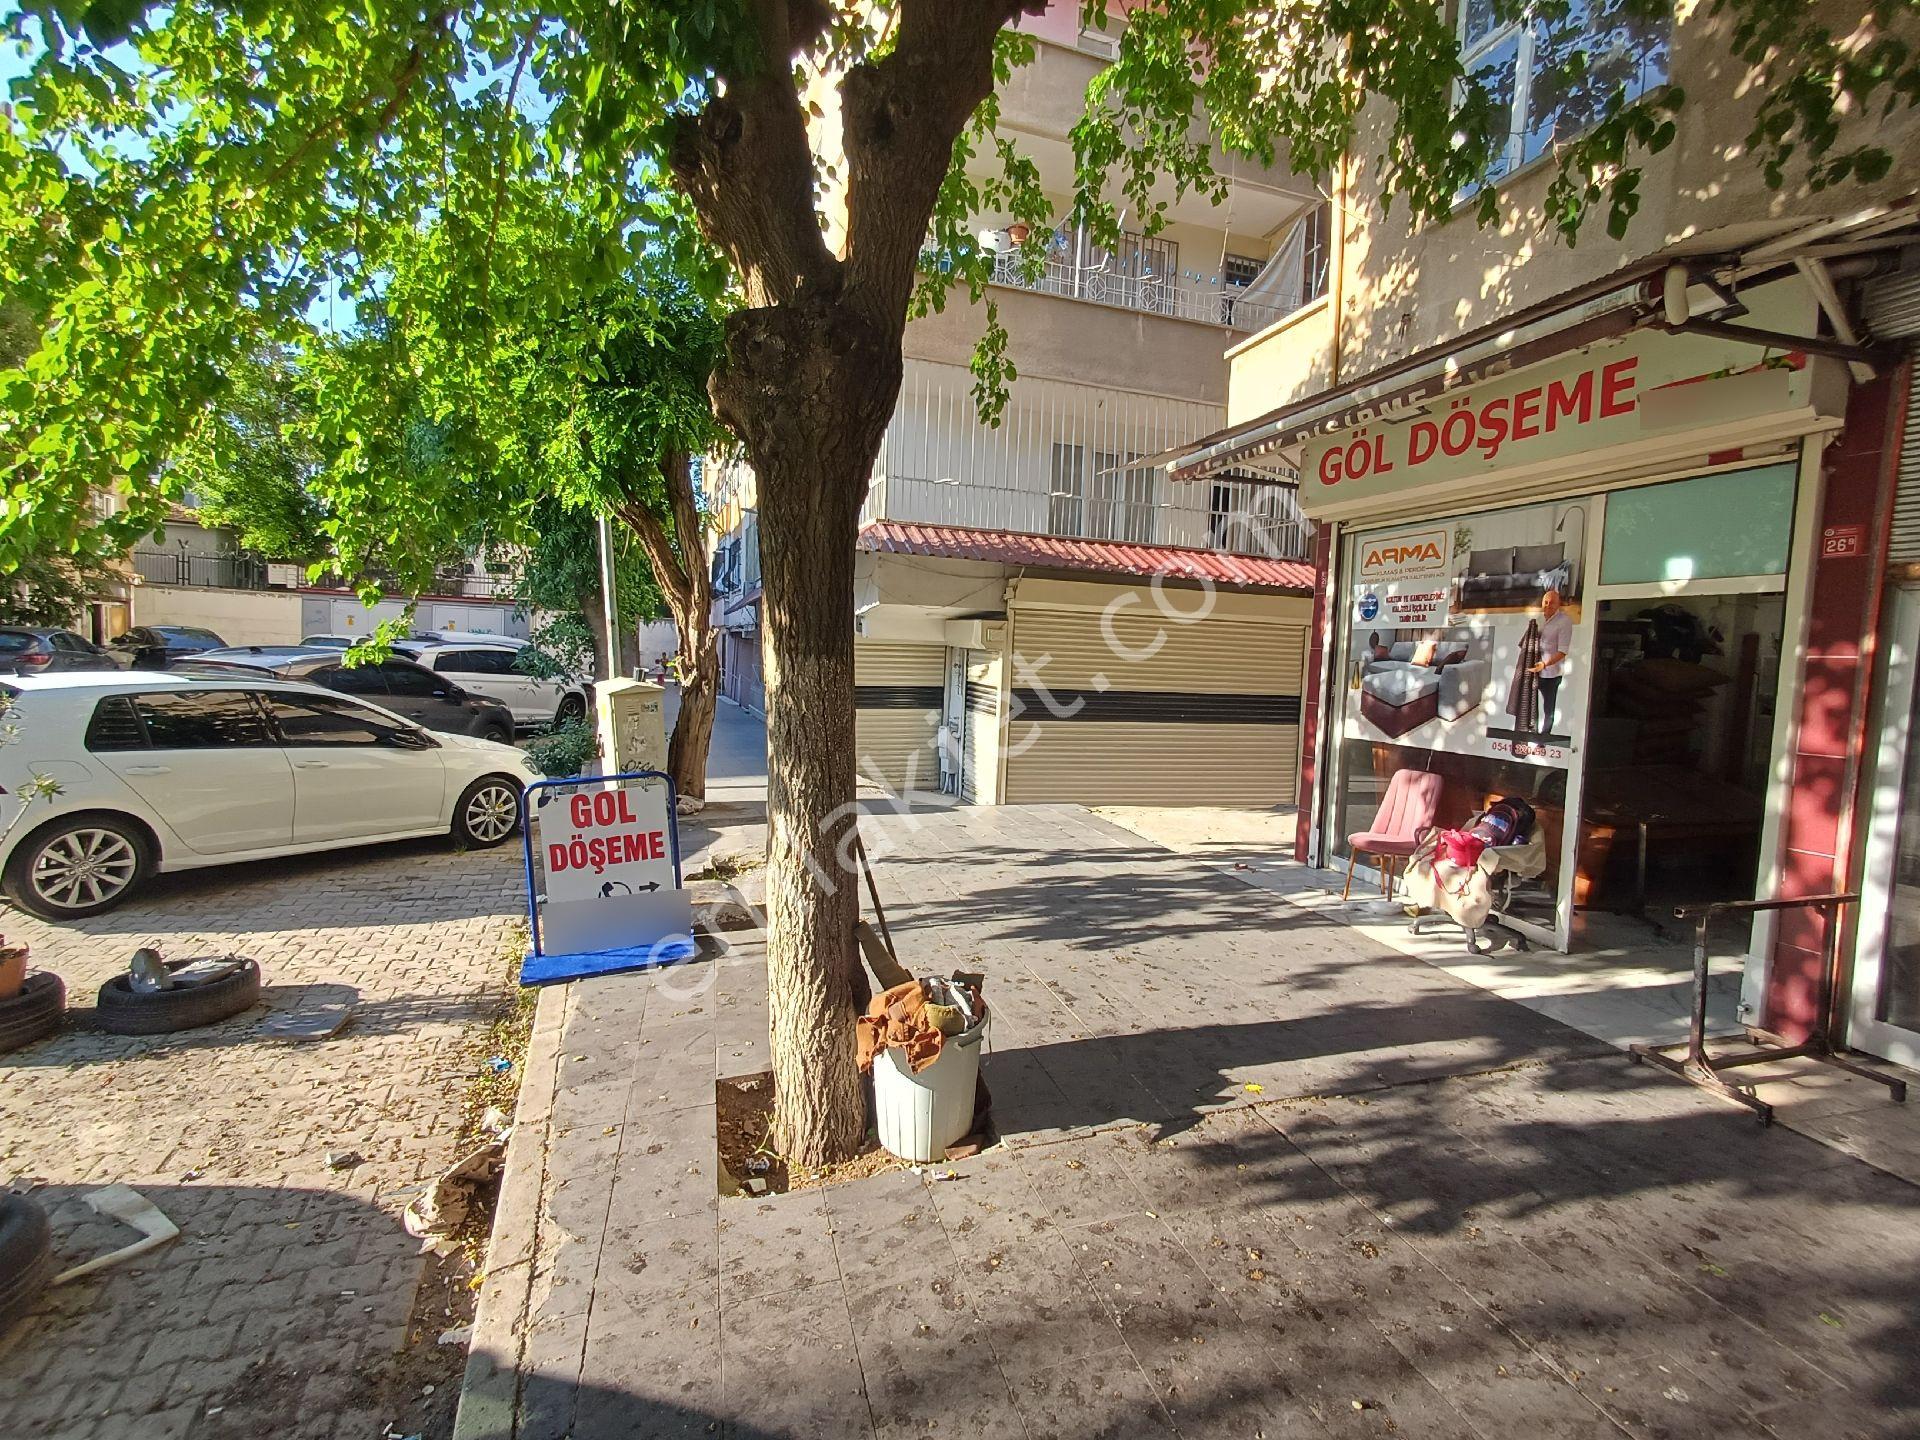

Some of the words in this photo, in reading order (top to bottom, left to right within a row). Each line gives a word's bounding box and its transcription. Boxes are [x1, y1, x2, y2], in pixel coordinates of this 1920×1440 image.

[1319, 428, 1393, 486] GÖL
[1407, 356, 1638, 460] DÖŞEME
[1364, 542, 1441, 568] ARMA
[570, 790, 637, 829] GOL
[549, 831, 665, 874] DÖŞEME
